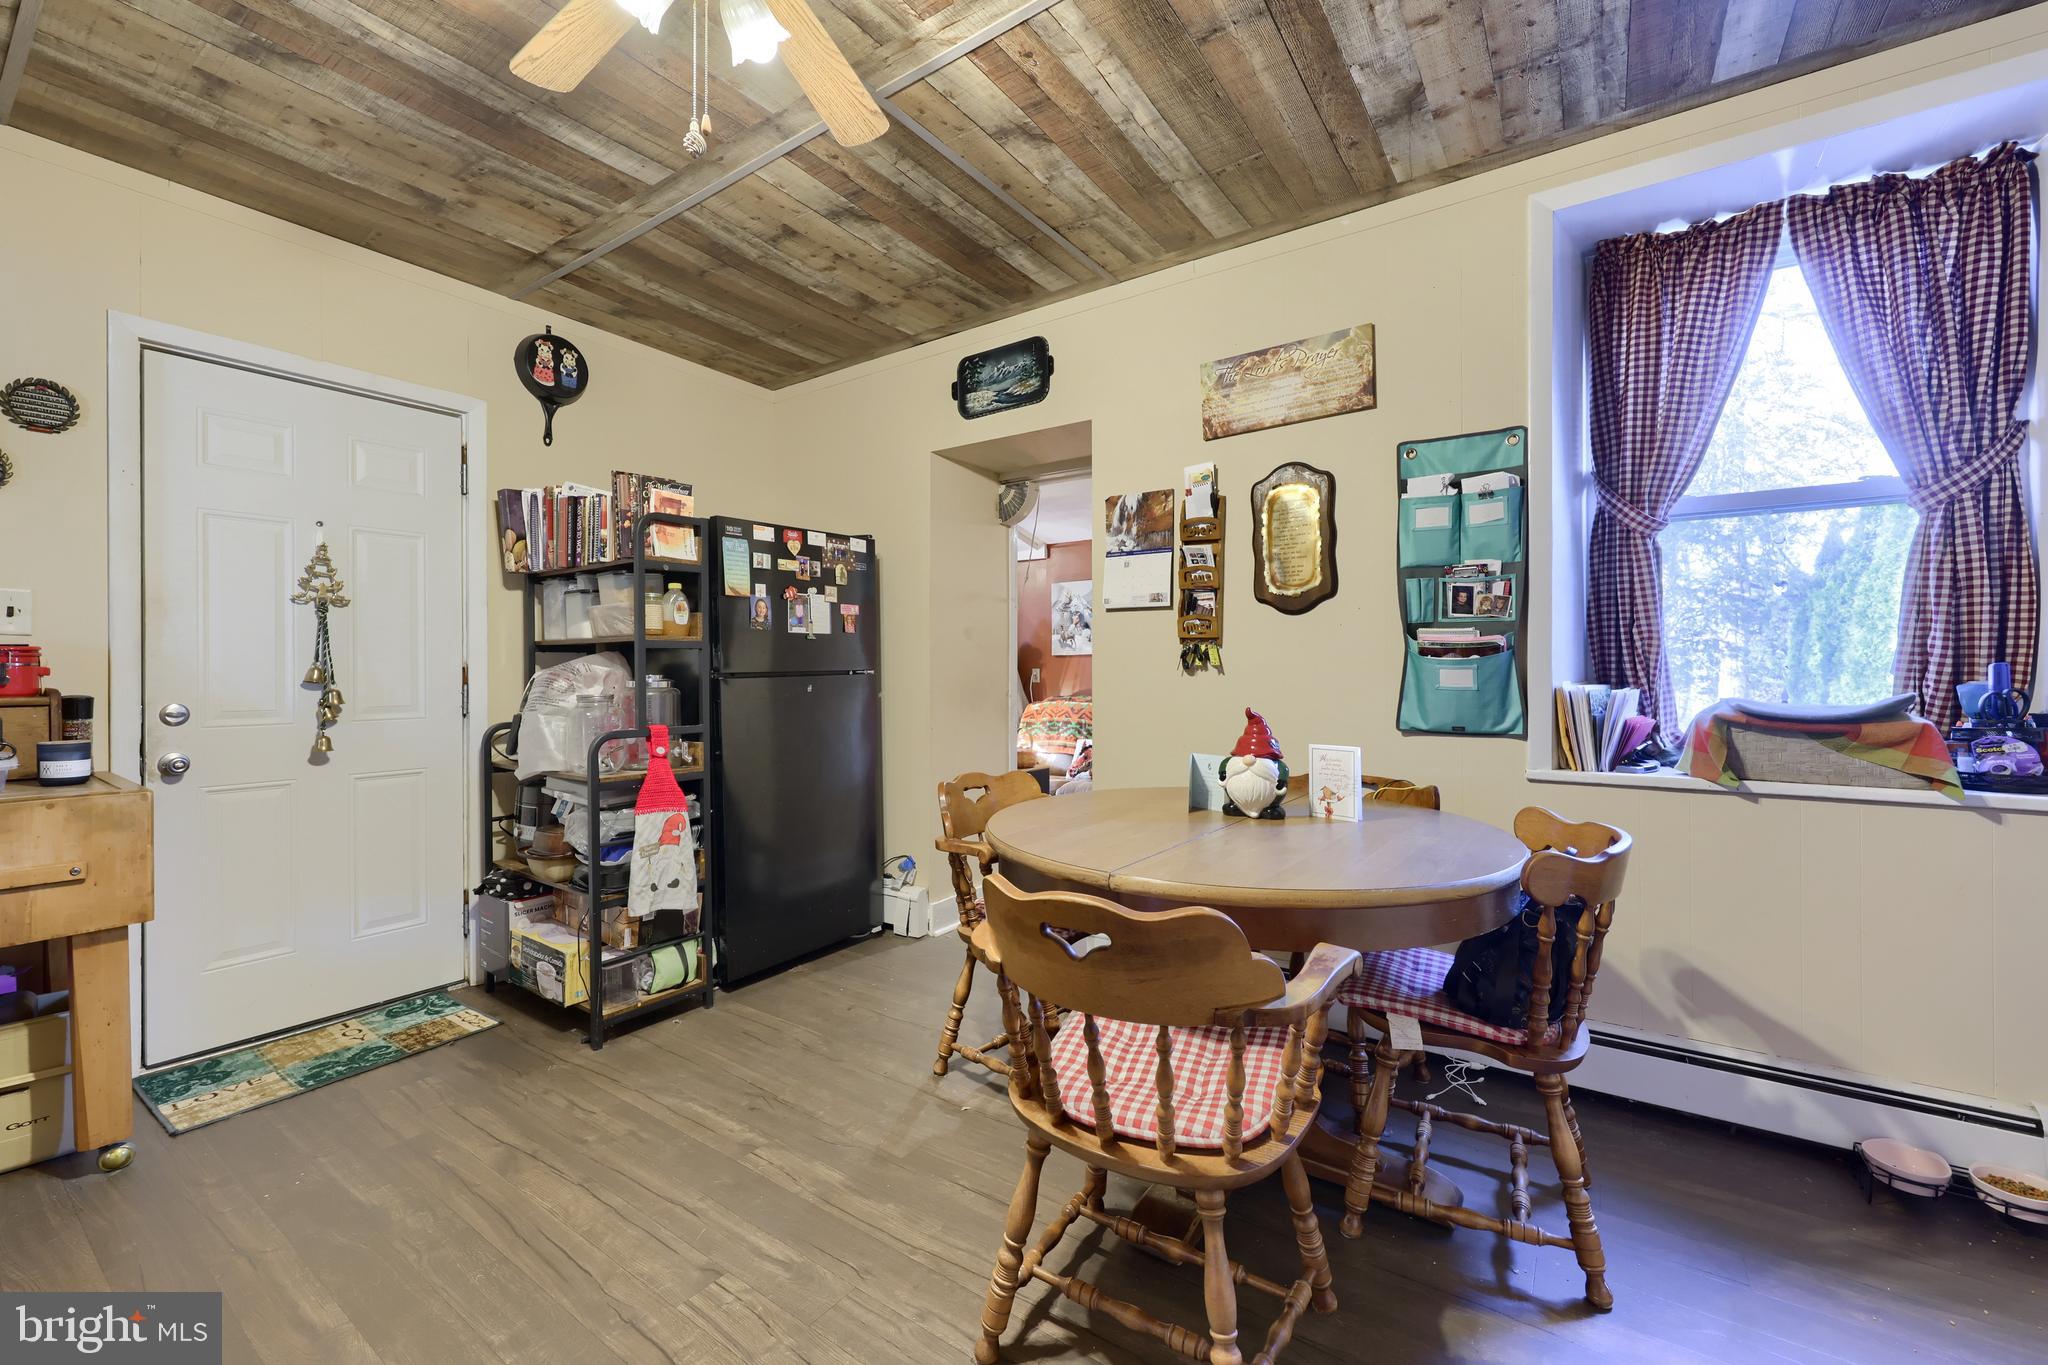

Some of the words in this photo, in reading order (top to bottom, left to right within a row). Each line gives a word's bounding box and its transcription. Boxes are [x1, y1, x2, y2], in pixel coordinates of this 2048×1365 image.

[1243, 347, 1290, 378] Lord's
[1287, 344, 1340, 379] Prayer
[514, 908, 533, 917] SLICER
[534, 903, 555, 913] MACH
[171, 1078, 263, 1111] LOVE
